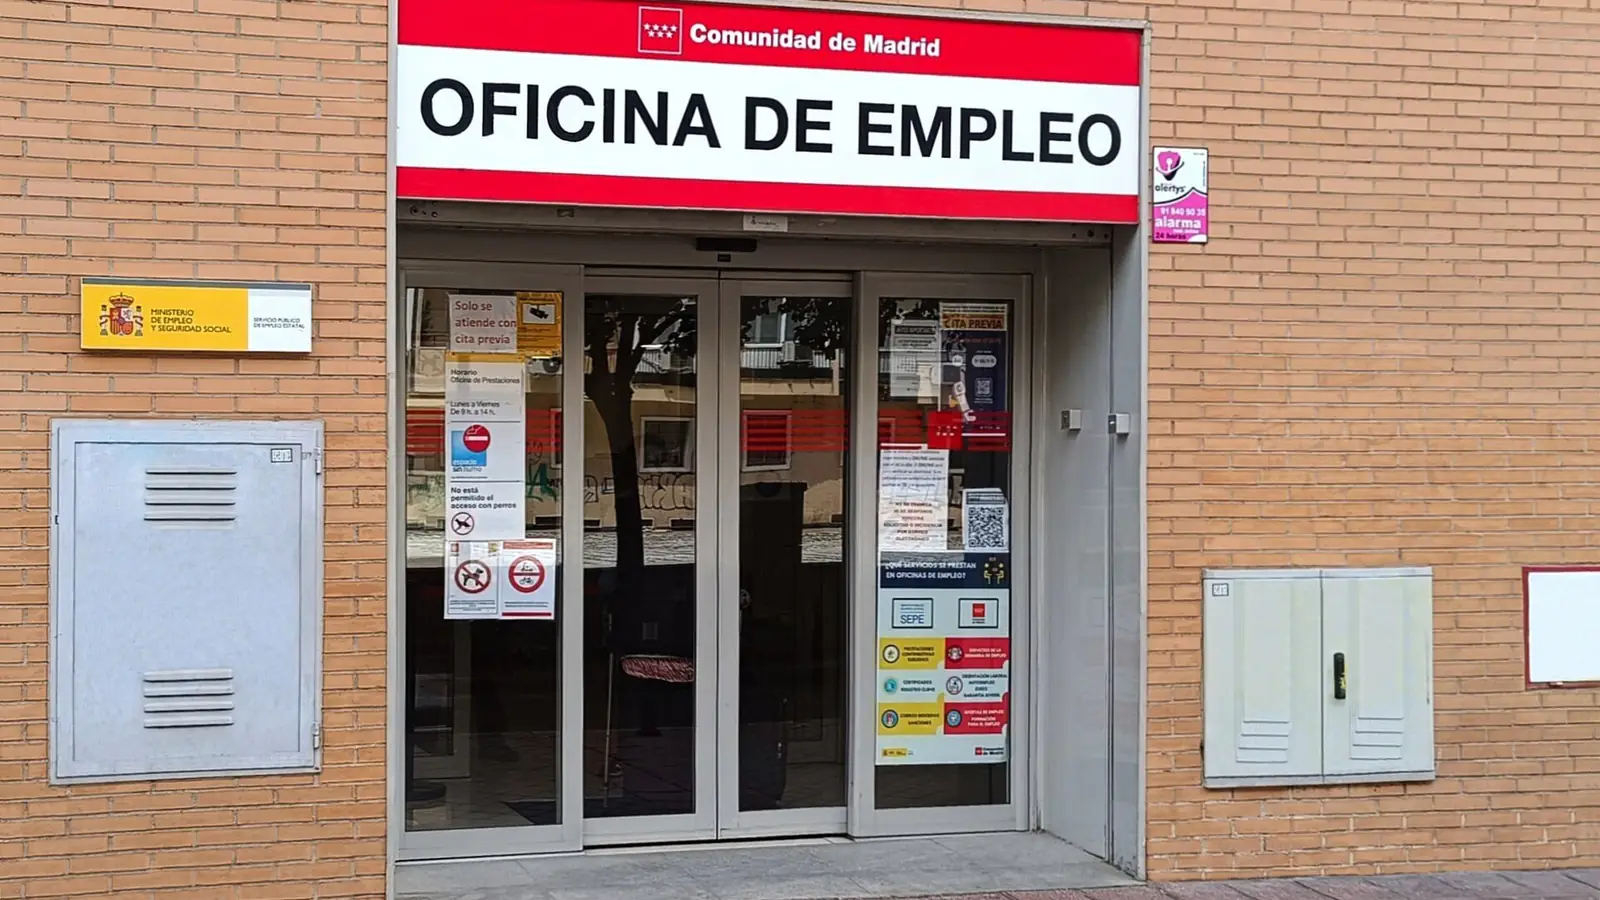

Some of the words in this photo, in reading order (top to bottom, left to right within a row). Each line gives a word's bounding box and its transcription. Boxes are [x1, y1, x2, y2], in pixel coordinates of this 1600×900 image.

[690, 23, 821, 50] Comunidad
[829, 32, 856, 51] de
[864, 34, 940, 57] Madrid
[420, 78, 721, 149] OFICINA
[745, 96, 833, 153] DE
[858, 102, 1122, 167] EMPLEO
[1155, 216, 1202, 229] alarma
[454, 300, 478, 311] Solo
[480, 303, 492, 311] se
[150, 308, 194, 316] MINISTERIO
[150, 316, 161, 324] DE
[163, 317, 193, 325] EMPLEO
[455, 317, 495, 328] atiende
[498, 319, 517, 328] con
[943, 319, 966, 329] CITA
[968, 319, 1003, 330] PREVIA
[158, 325, 201, 333] SEGURIDAD
[203, 326, 232, 334] SOCIAL
[455, 334, 475, 344] cita
[478, 335, 510, 345] previa
[451, 494, 485, 502] permitido
[903, 561, 938, 569] SERVICIOS
[900, 614, 925, 624] SEPE
